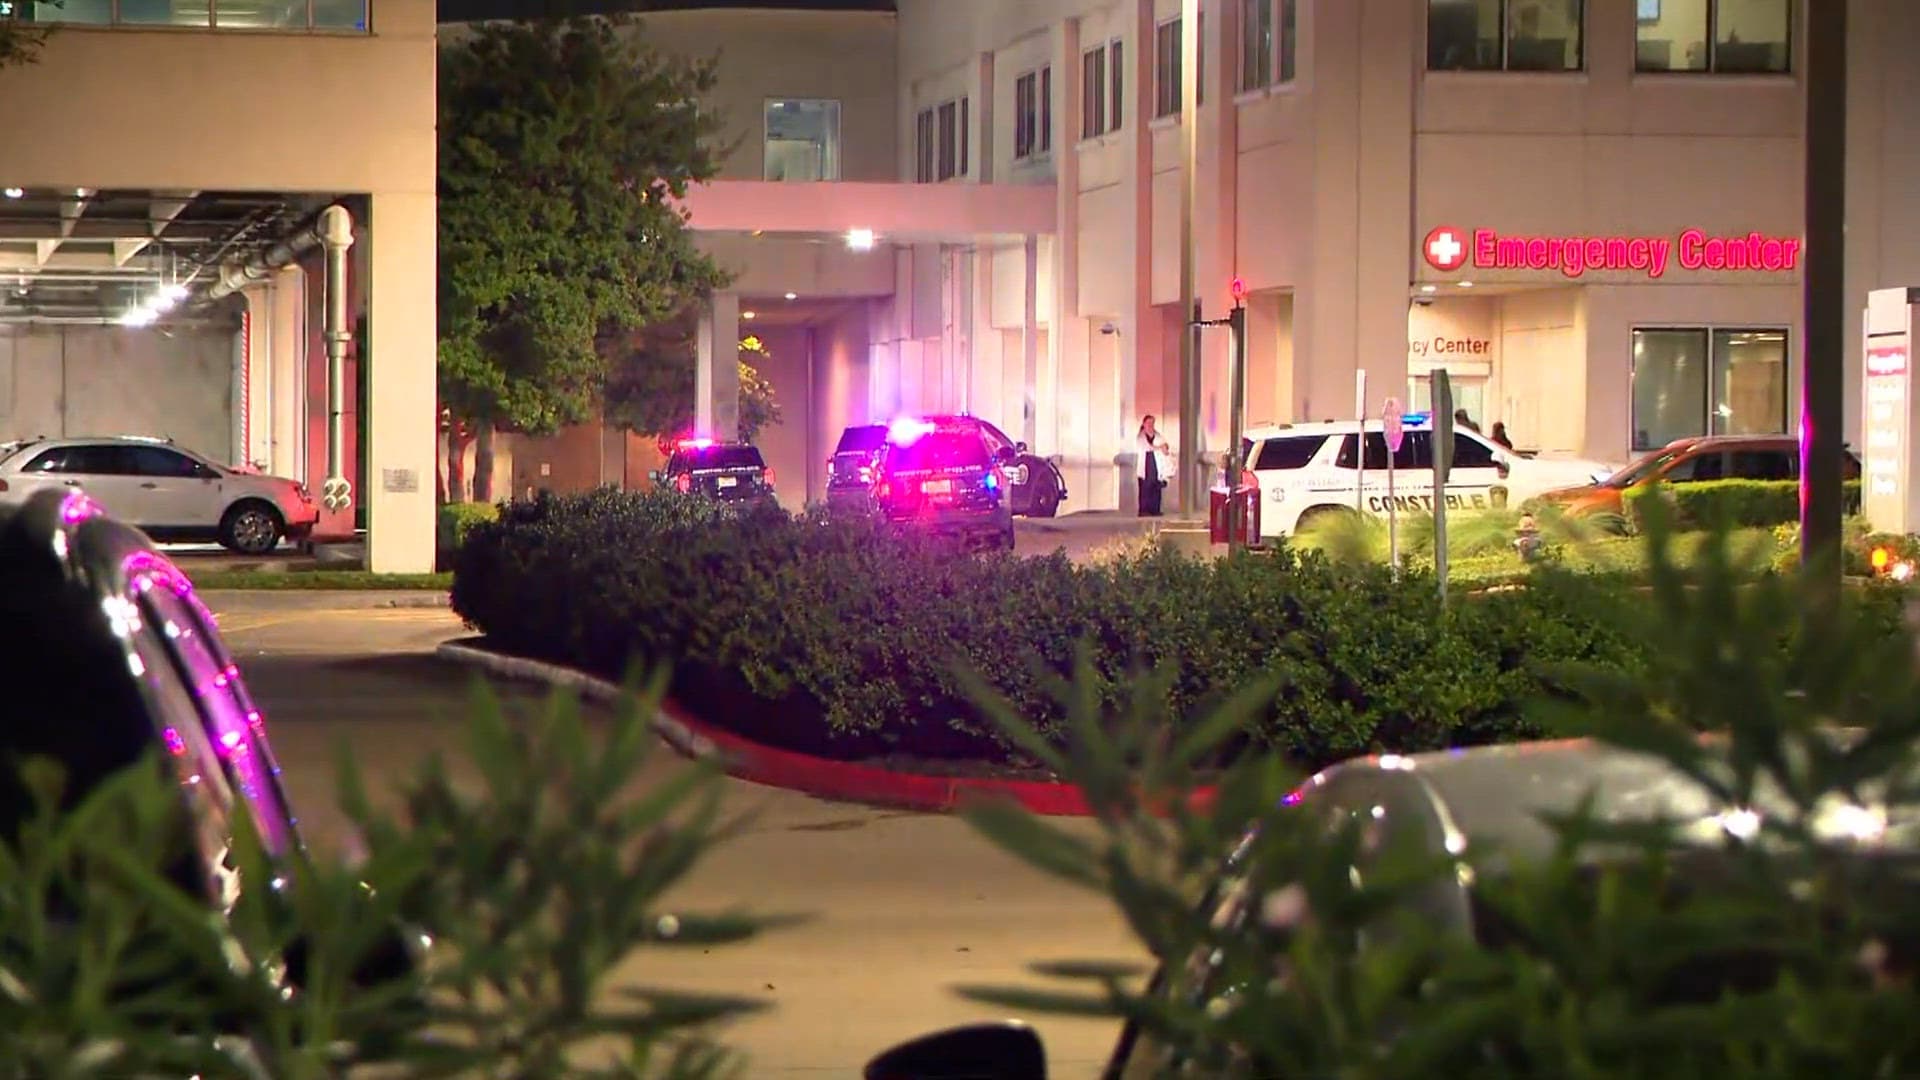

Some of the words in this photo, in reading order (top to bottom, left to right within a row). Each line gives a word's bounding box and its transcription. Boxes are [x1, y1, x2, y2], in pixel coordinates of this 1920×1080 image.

[1473, 230, 1672, 277] Emergency
[1680, 228, 1801, 271] Center
[1408, 340, 1429, 357] cy
[1434, 337, 1490, 354] Center
[1369, 494, 1487, 512] CONSTBLE
